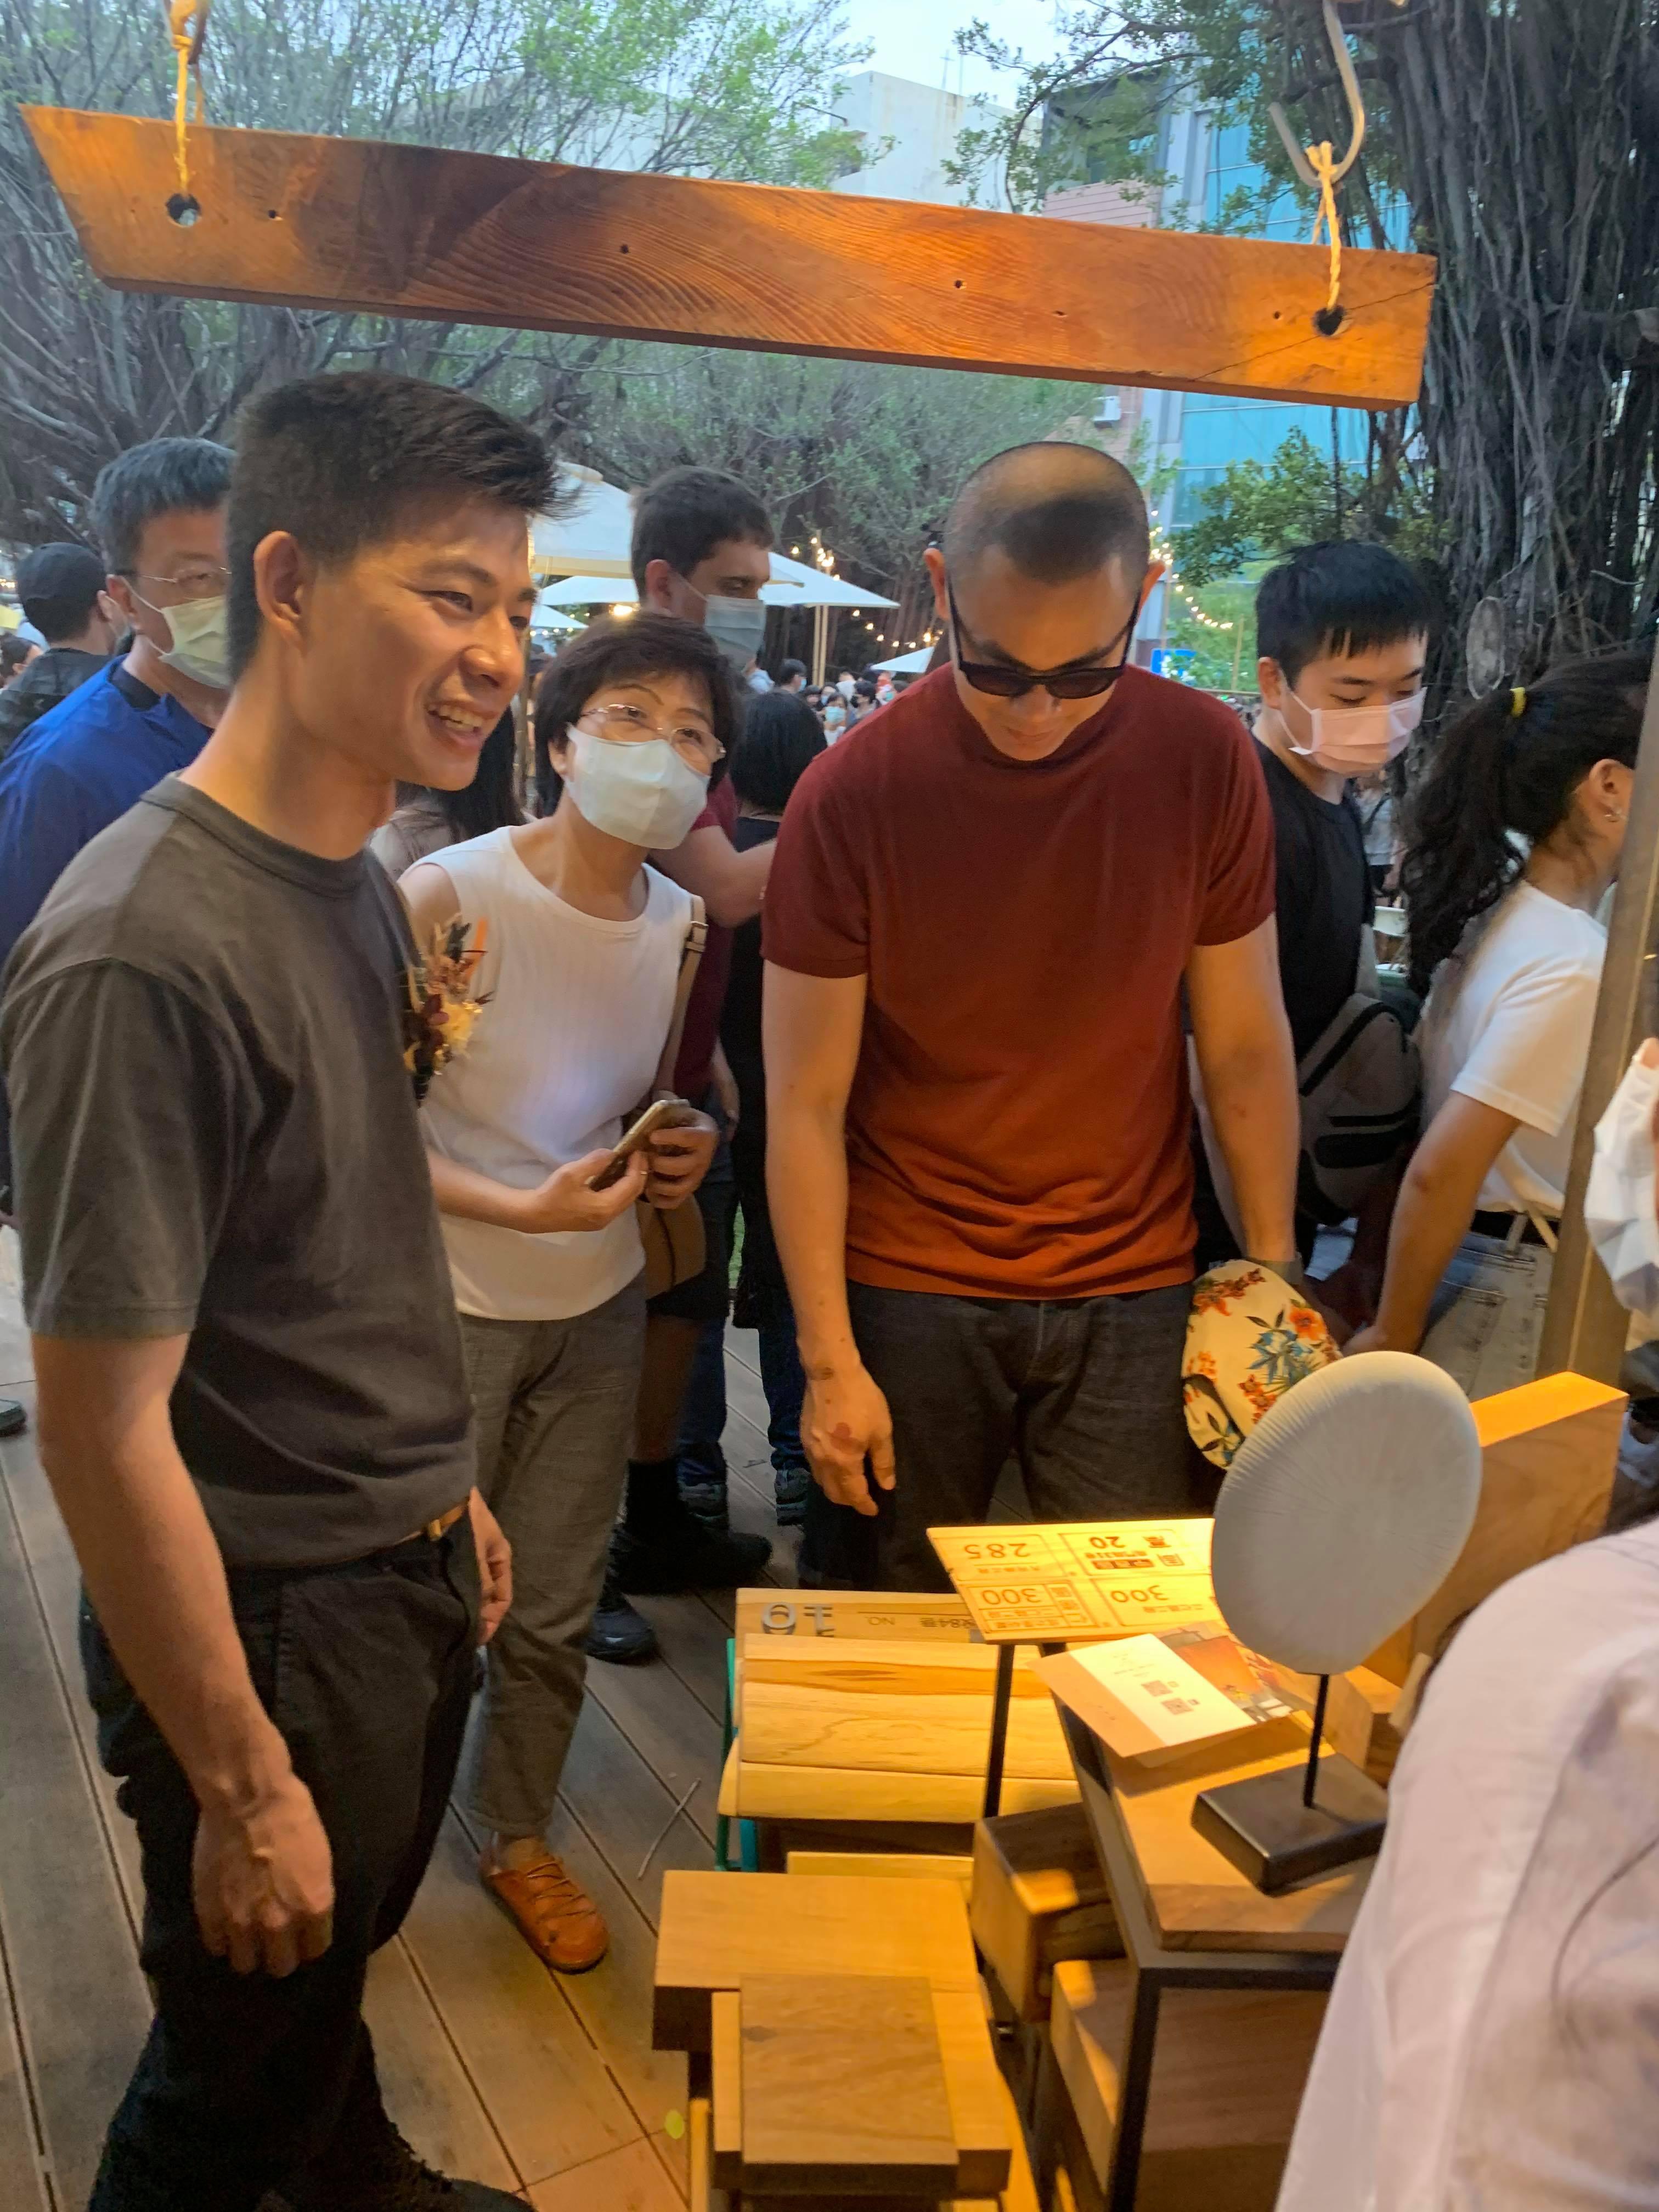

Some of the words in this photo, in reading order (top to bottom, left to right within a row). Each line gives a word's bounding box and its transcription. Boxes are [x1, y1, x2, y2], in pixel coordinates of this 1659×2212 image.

[964, 1542, 1030, 1560] 285
[1090, 1536, 1125, 1549] 20
[981, 1588, 1041, 1605] 300
[1111, 1585, 1170, 1603] 300
[865, 1616, 896, 1626] NO.
